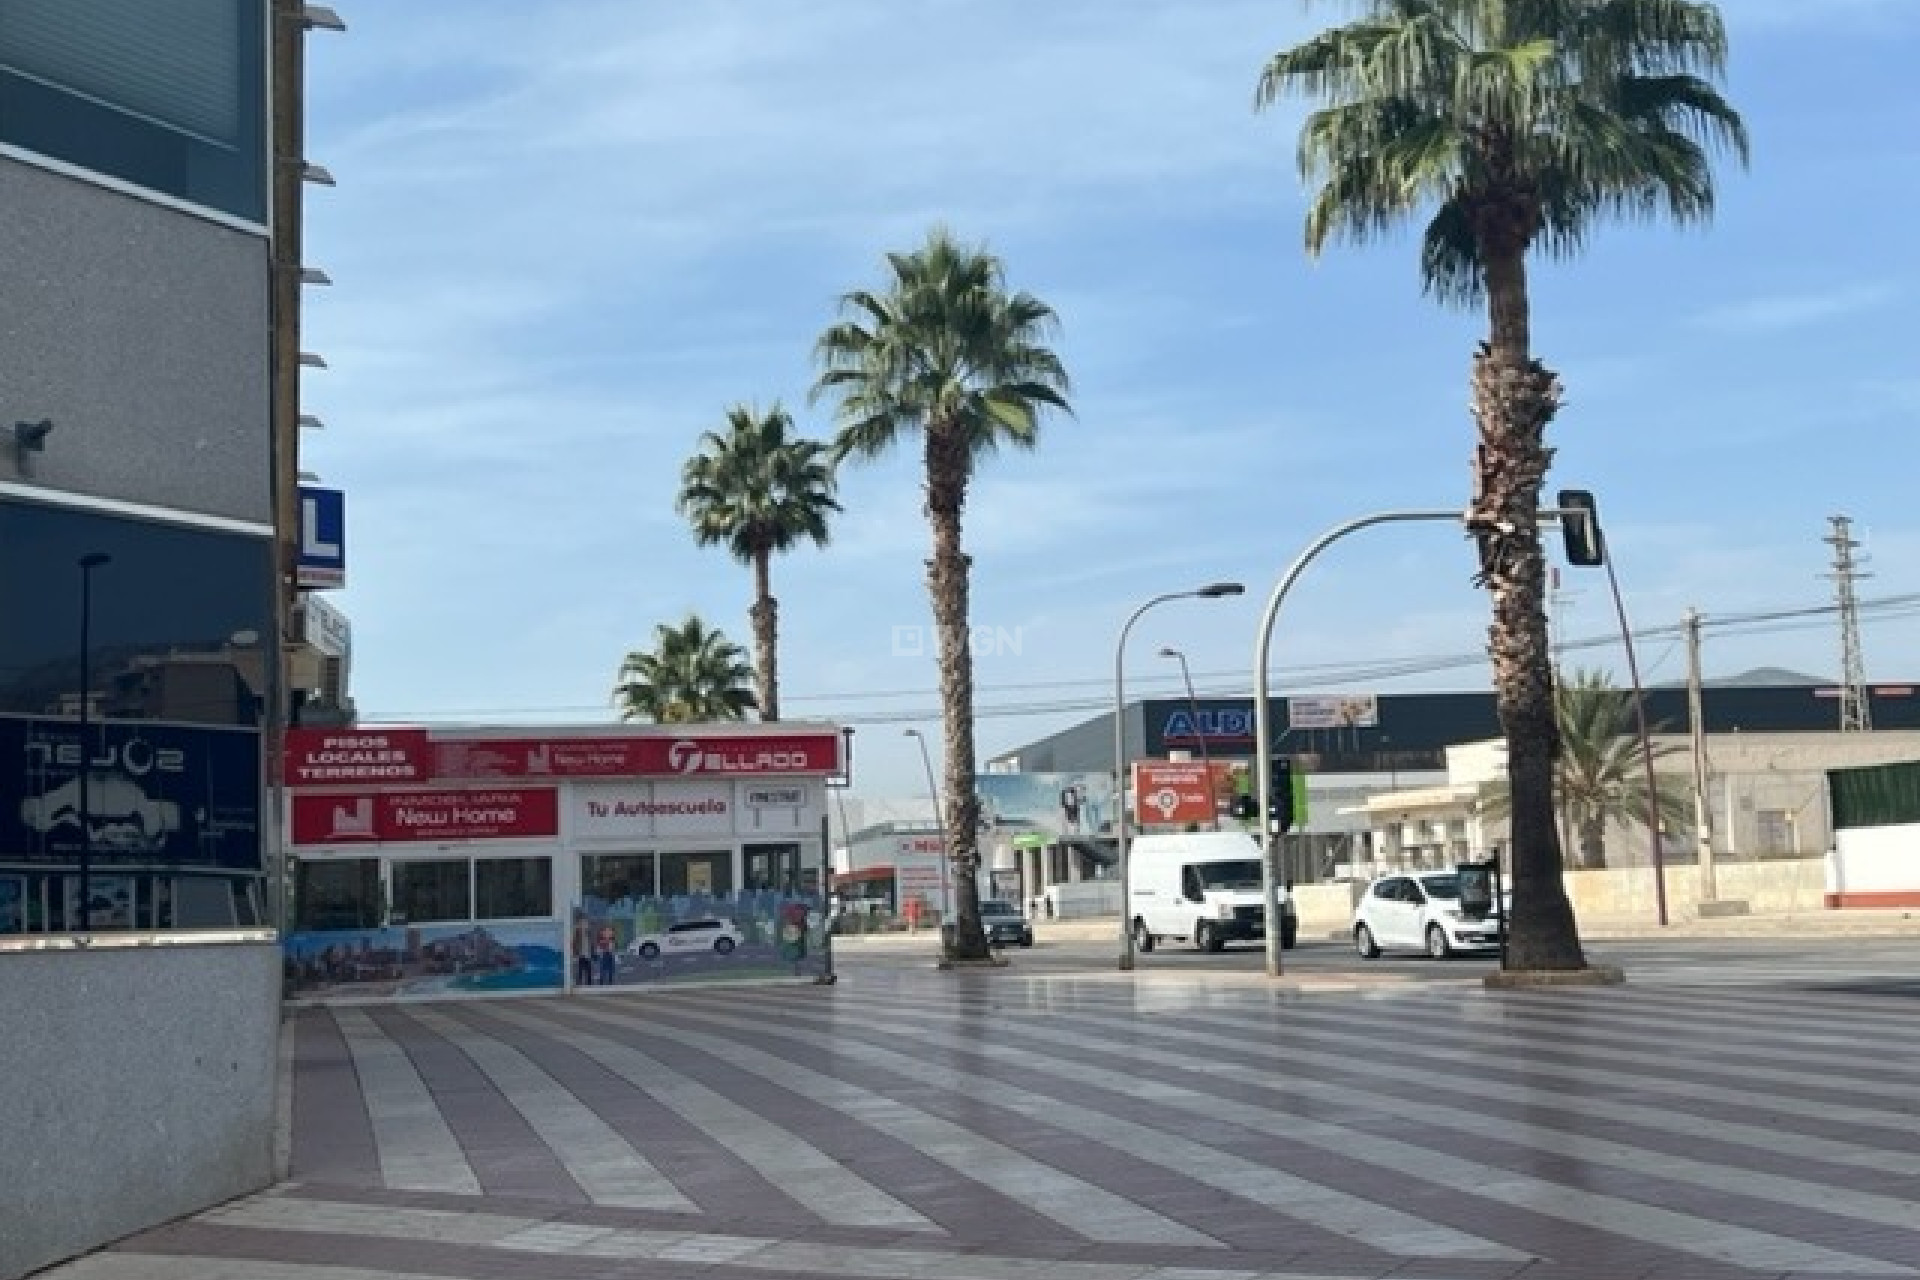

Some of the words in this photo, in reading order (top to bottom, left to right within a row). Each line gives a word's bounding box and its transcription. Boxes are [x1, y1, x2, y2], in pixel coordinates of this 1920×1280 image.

[302, 499, 340, 559] L
[323, 736, 388, 749] PISOS
[306, 751, 406, 764] LOCALES
[297, 766, 415, 779] TERRENOS
[395, 807, 449, 826] New
[452, 806, 517, 825] Home
[587, 801, 607, 818] Tu
[614, 798, 727, 817] Autoescuela
